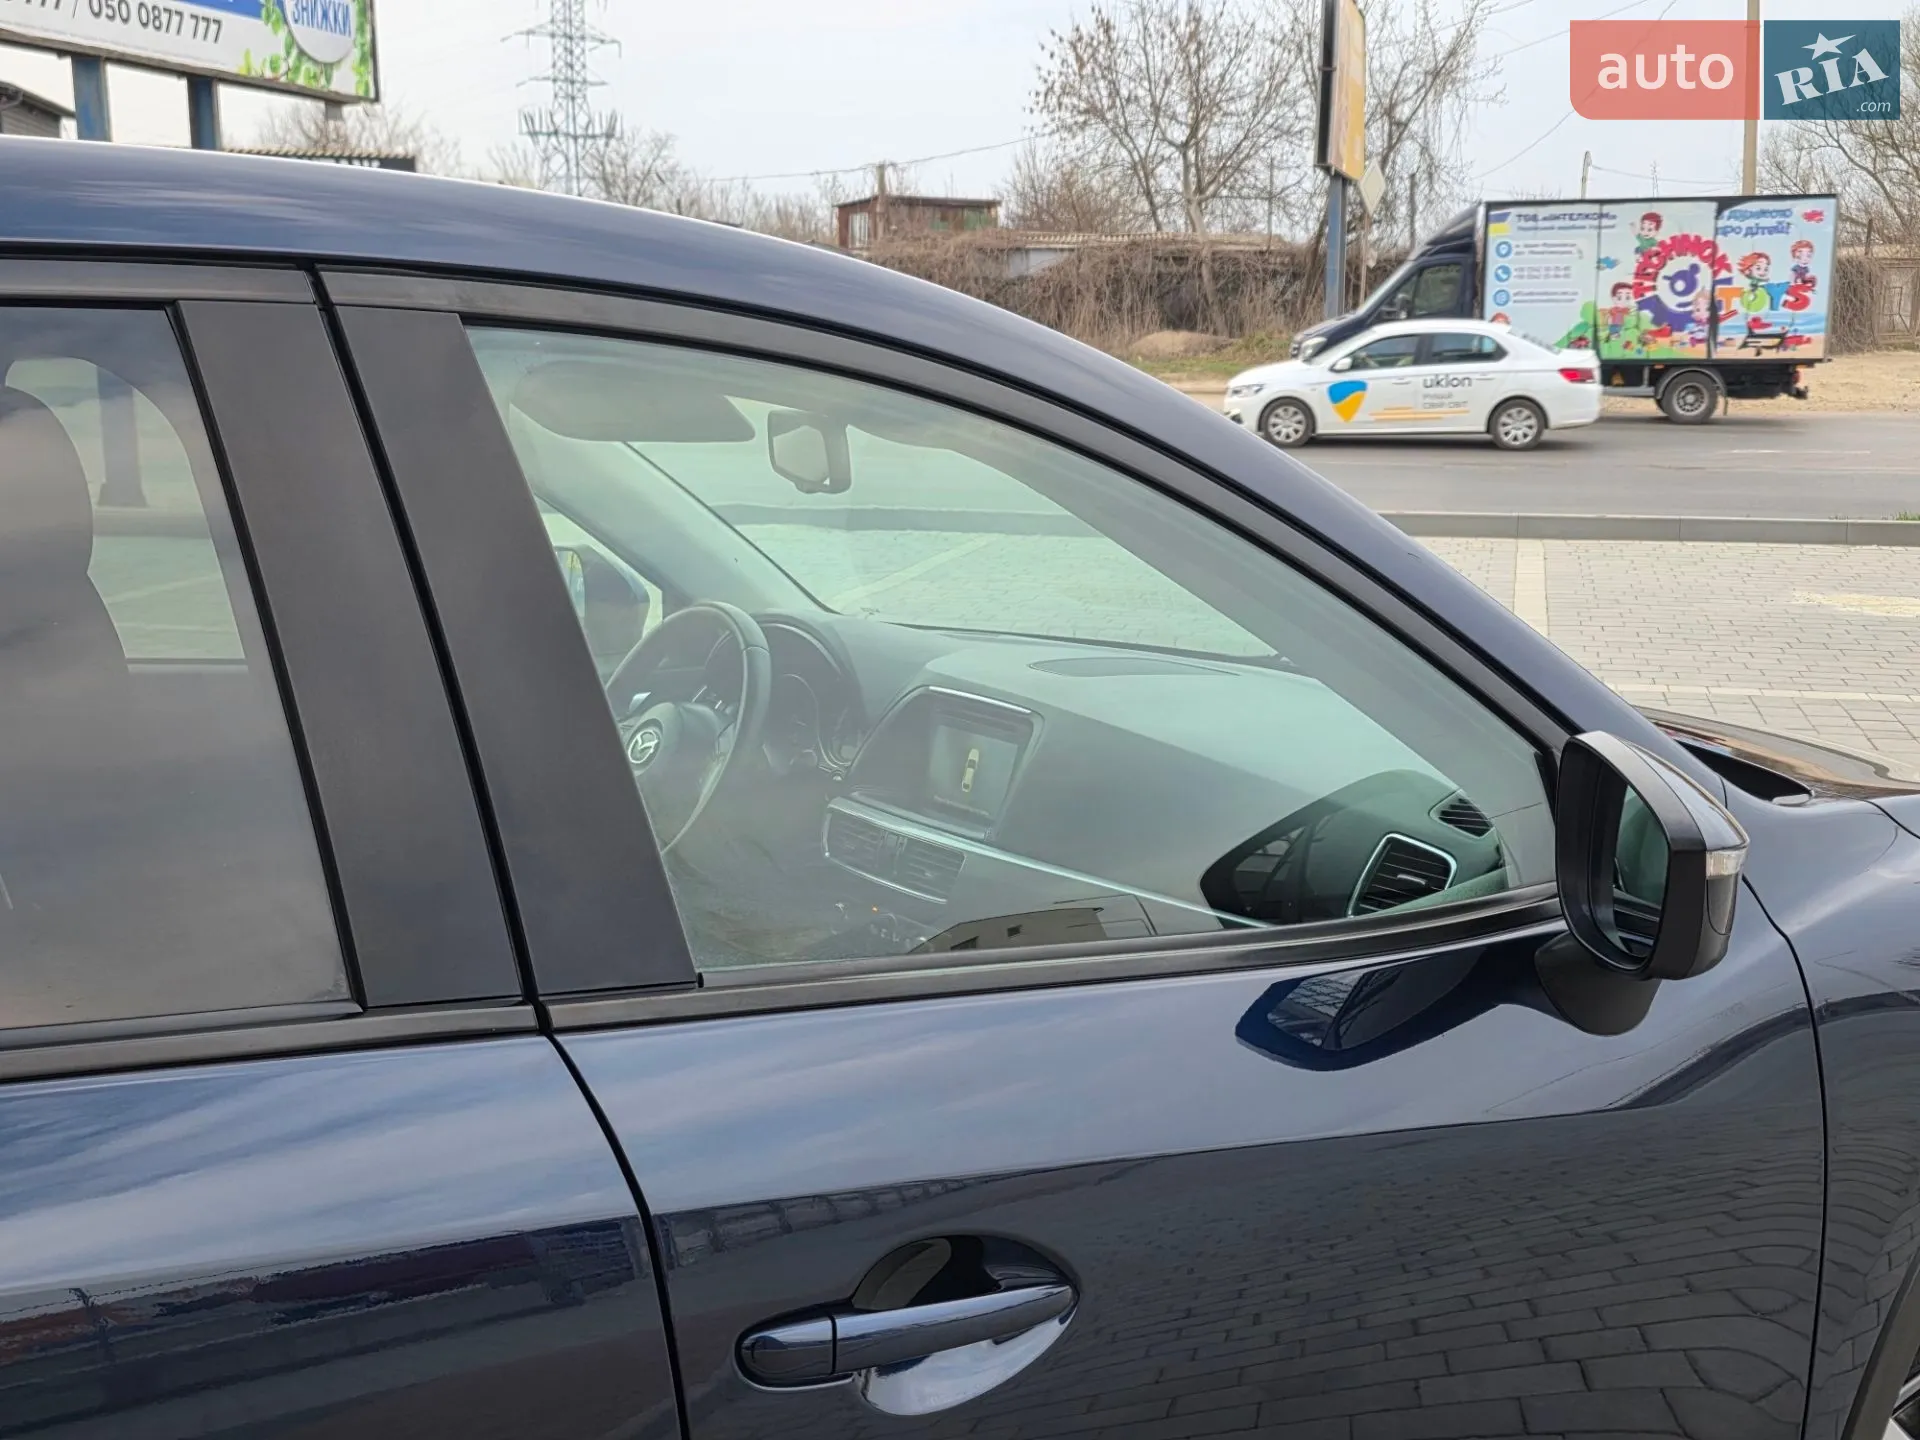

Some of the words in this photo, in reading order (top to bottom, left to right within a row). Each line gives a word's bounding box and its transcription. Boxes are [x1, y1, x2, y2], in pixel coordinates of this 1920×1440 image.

[88, 0, 131, 24] 050
[138, 2, 184, 36] 0877
[190, 13, 223, 44] 777
[293, 0, 352, 38] ЗНИЖКИ
[1715, 281, 1814, 312] TOYS
[1423, 373, 1472, 389] uklon
